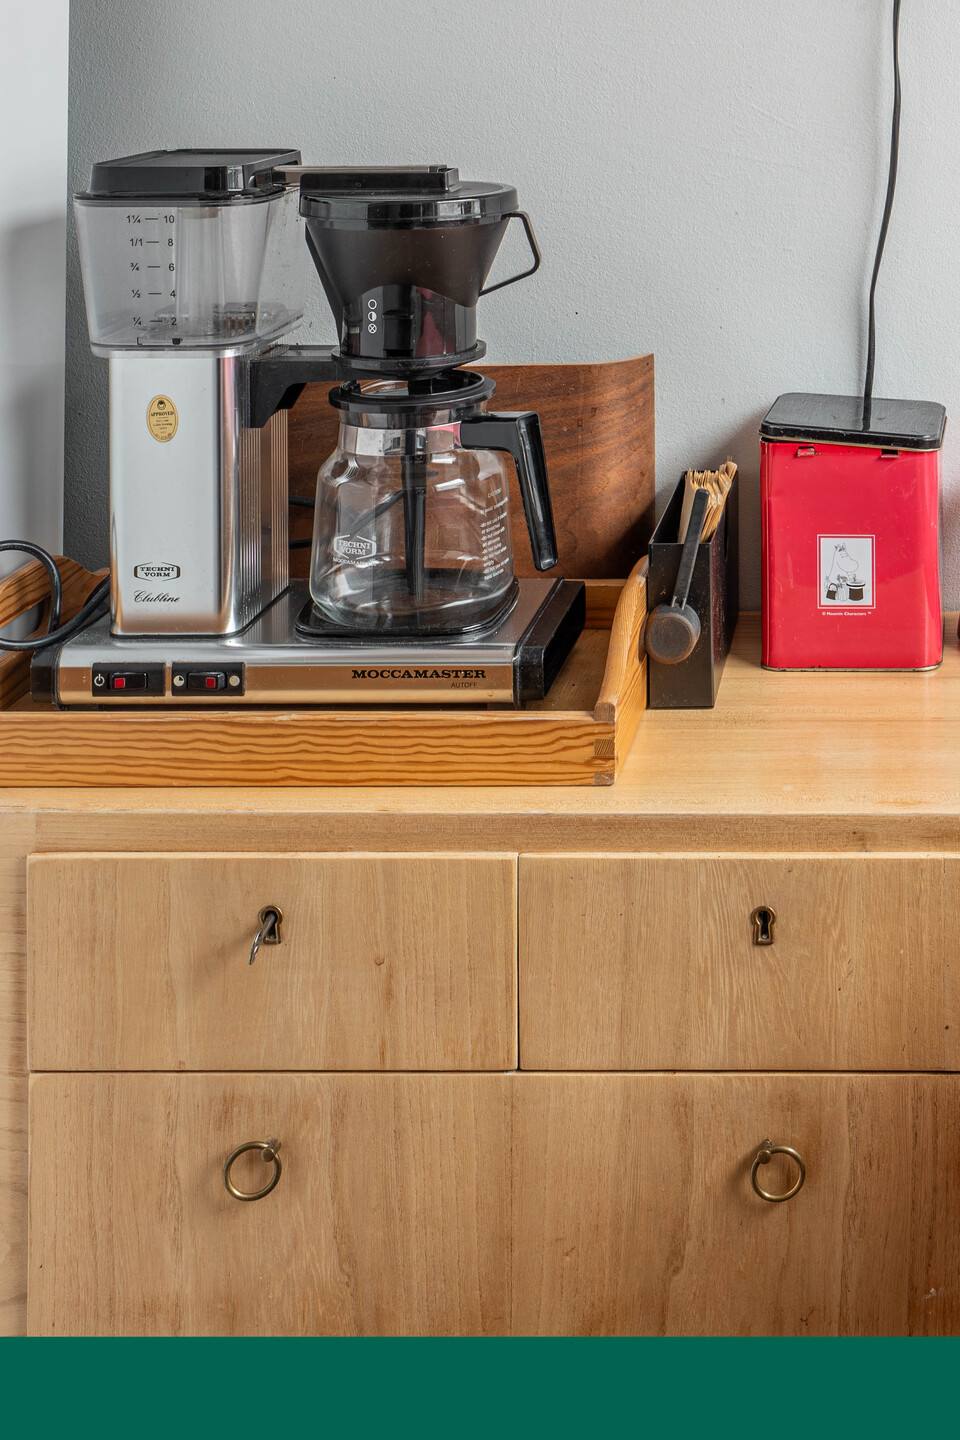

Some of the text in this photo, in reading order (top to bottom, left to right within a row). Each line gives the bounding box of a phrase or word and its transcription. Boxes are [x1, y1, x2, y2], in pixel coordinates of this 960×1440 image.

[164, 215, 174, 223] 10
[130, 238, 174, 247] 1/1 8
[169, 263, 174, 271] 6
[171, 317, 177, 326] 2
[338, 540, 370, 549] TECHNI
[341, 547, 366, 555] VORM
[134, 590, 180, 603] Clubline
[352, 670, 486, 679] MOCCAMASTER
